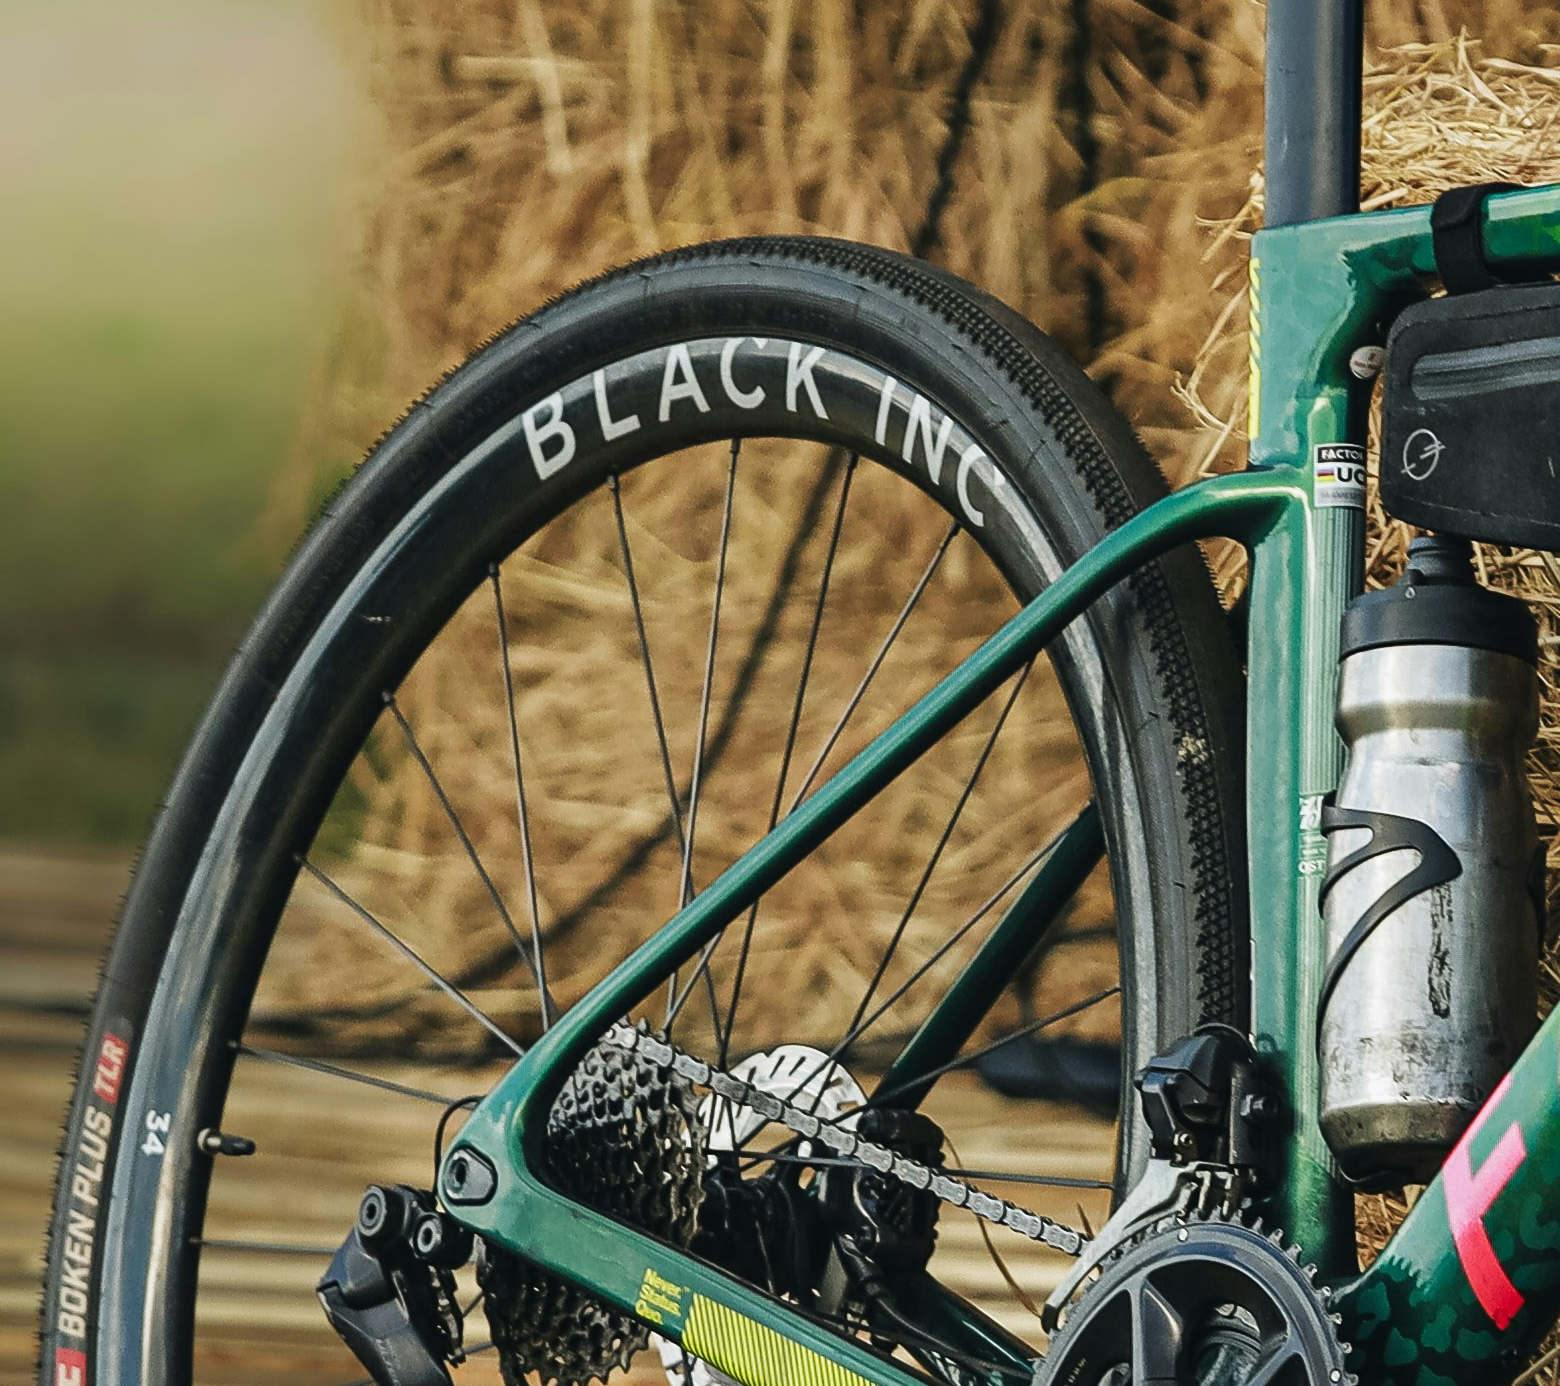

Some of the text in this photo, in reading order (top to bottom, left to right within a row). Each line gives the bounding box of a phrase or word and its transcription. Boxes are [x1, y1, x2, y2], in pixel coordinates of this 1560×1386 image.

[521, 334, 1007, 527] BLACK INC
[93, 1038, 128, 1097] TLR
[72, 1105, 113, 1207] PLUS
[141, 1109, 170, 1156] 34
[57, 1219, 95, 1339] BOKEN
